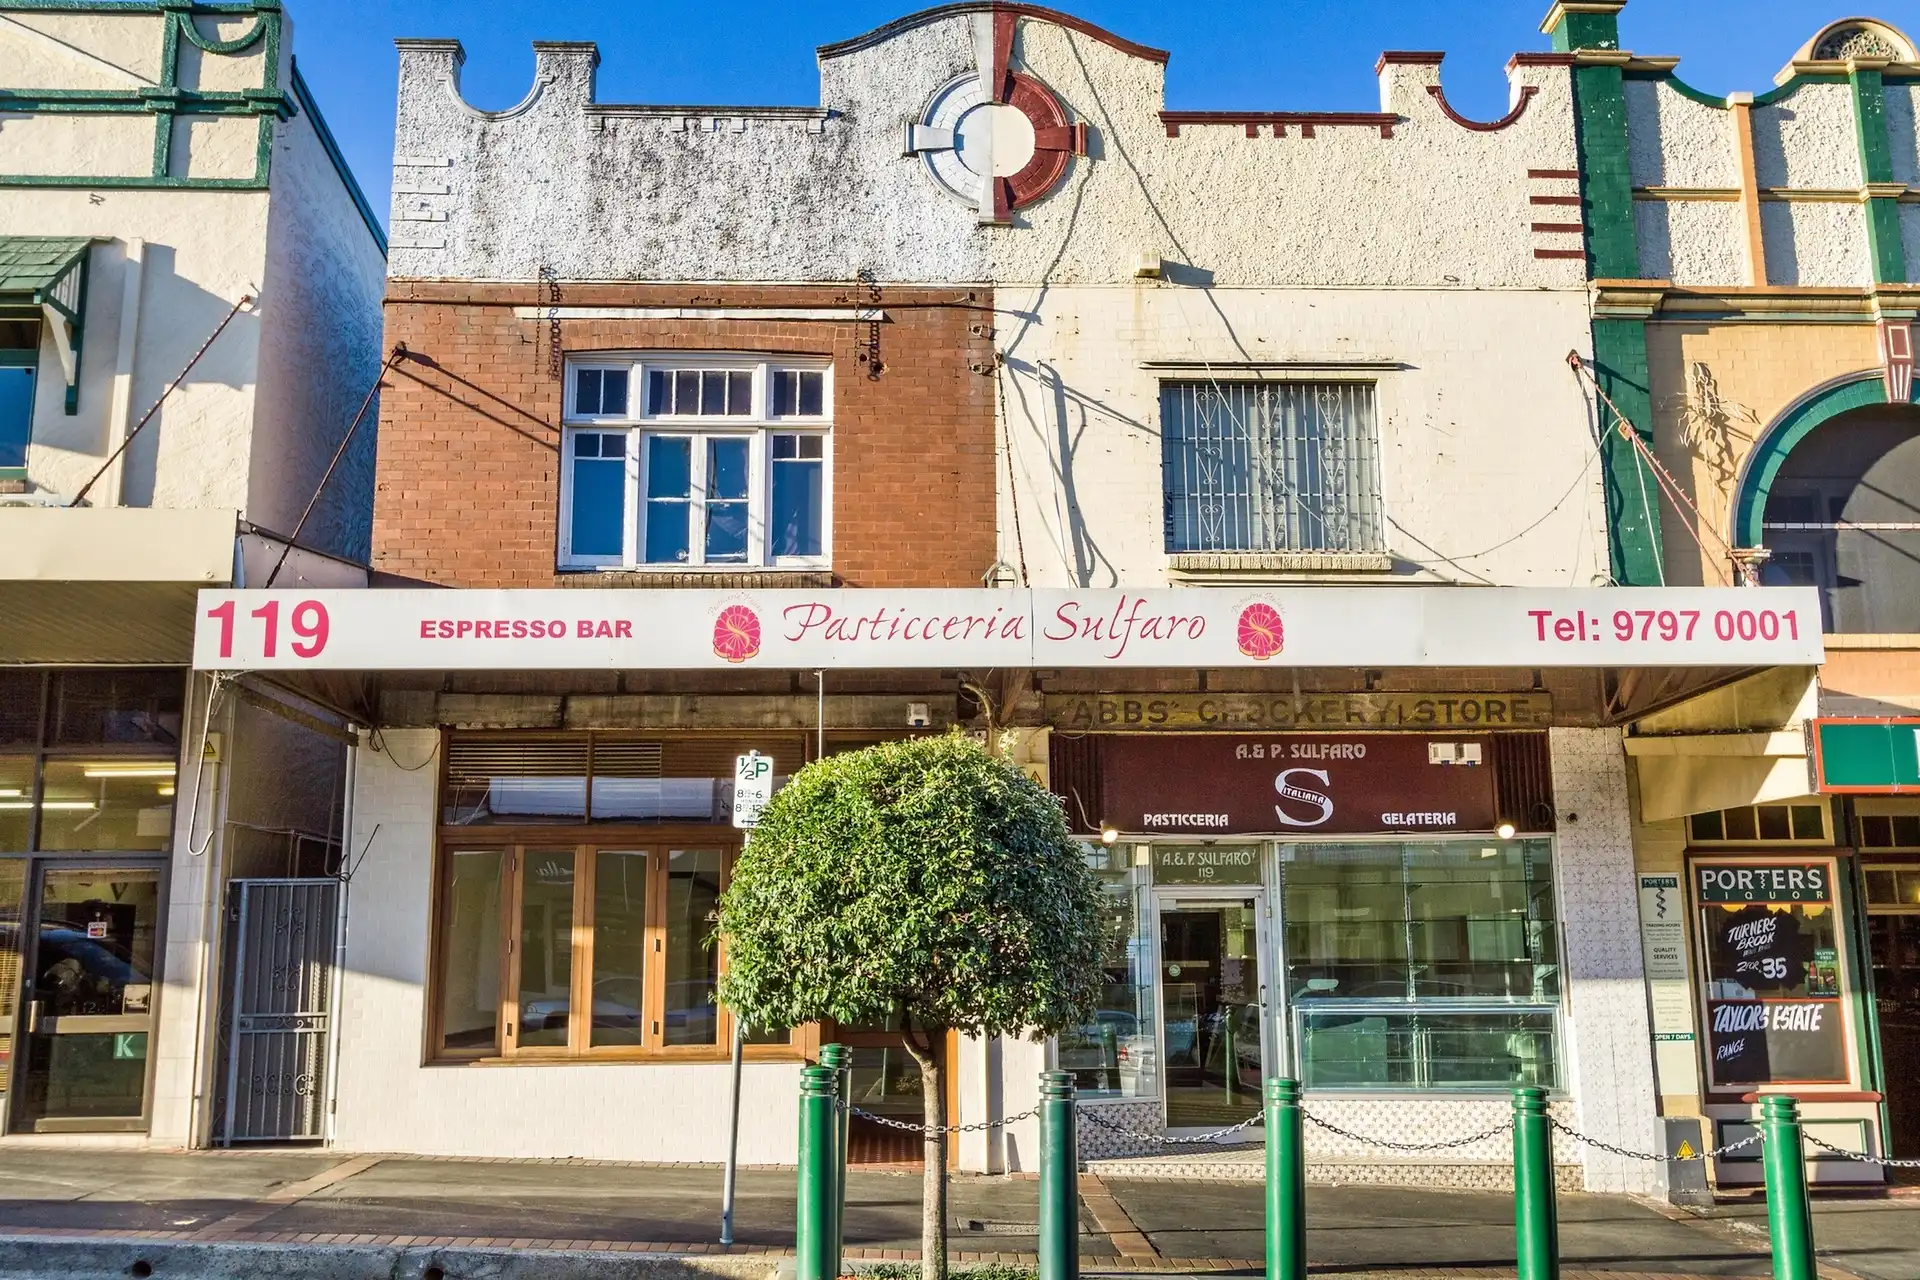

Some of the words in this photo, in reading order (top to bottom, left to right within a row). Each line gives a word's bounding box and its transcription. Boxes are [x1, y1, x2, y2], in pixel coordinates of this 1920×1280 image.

[207, 600, 330, 658] 119
[419, 620, 567, 639] ESPRESSO
[577, 620, 633, 639] BAR
[783, 602, 1026, 642] Pasticceria
[1043, 595, 1206, 658] Sulfaro
[1528, 610, 1600, 641] Tel:
[1612, 610, 1700, 641] 9797
[1714, 610, 1799, 641] 0001
[1270, 743, 1285, 759] P.
[1290, 743, 1367, 760] SULFARO
[1283, 787, 1325, 804] ITALIANA
[1143, 813, 1229, 828] PASTICCERIA
[1381, 812, 1456, 826] GELATERIA
[1197, 851, 1251, 866] SULFARO
[1198, 867, 1214, 878] 119
[1703, 890, 1824, 900] LIQUOR
[1728, 917, 1777, 943] TURNERS
[1736, 932, 1775, 951] BROOK
[1713, 1004, 1770, 1032] TAYLORS
[1772, 1004, 1824, 1032] ESTATE
[1717, 1038, 1745, 1060] RANGE
